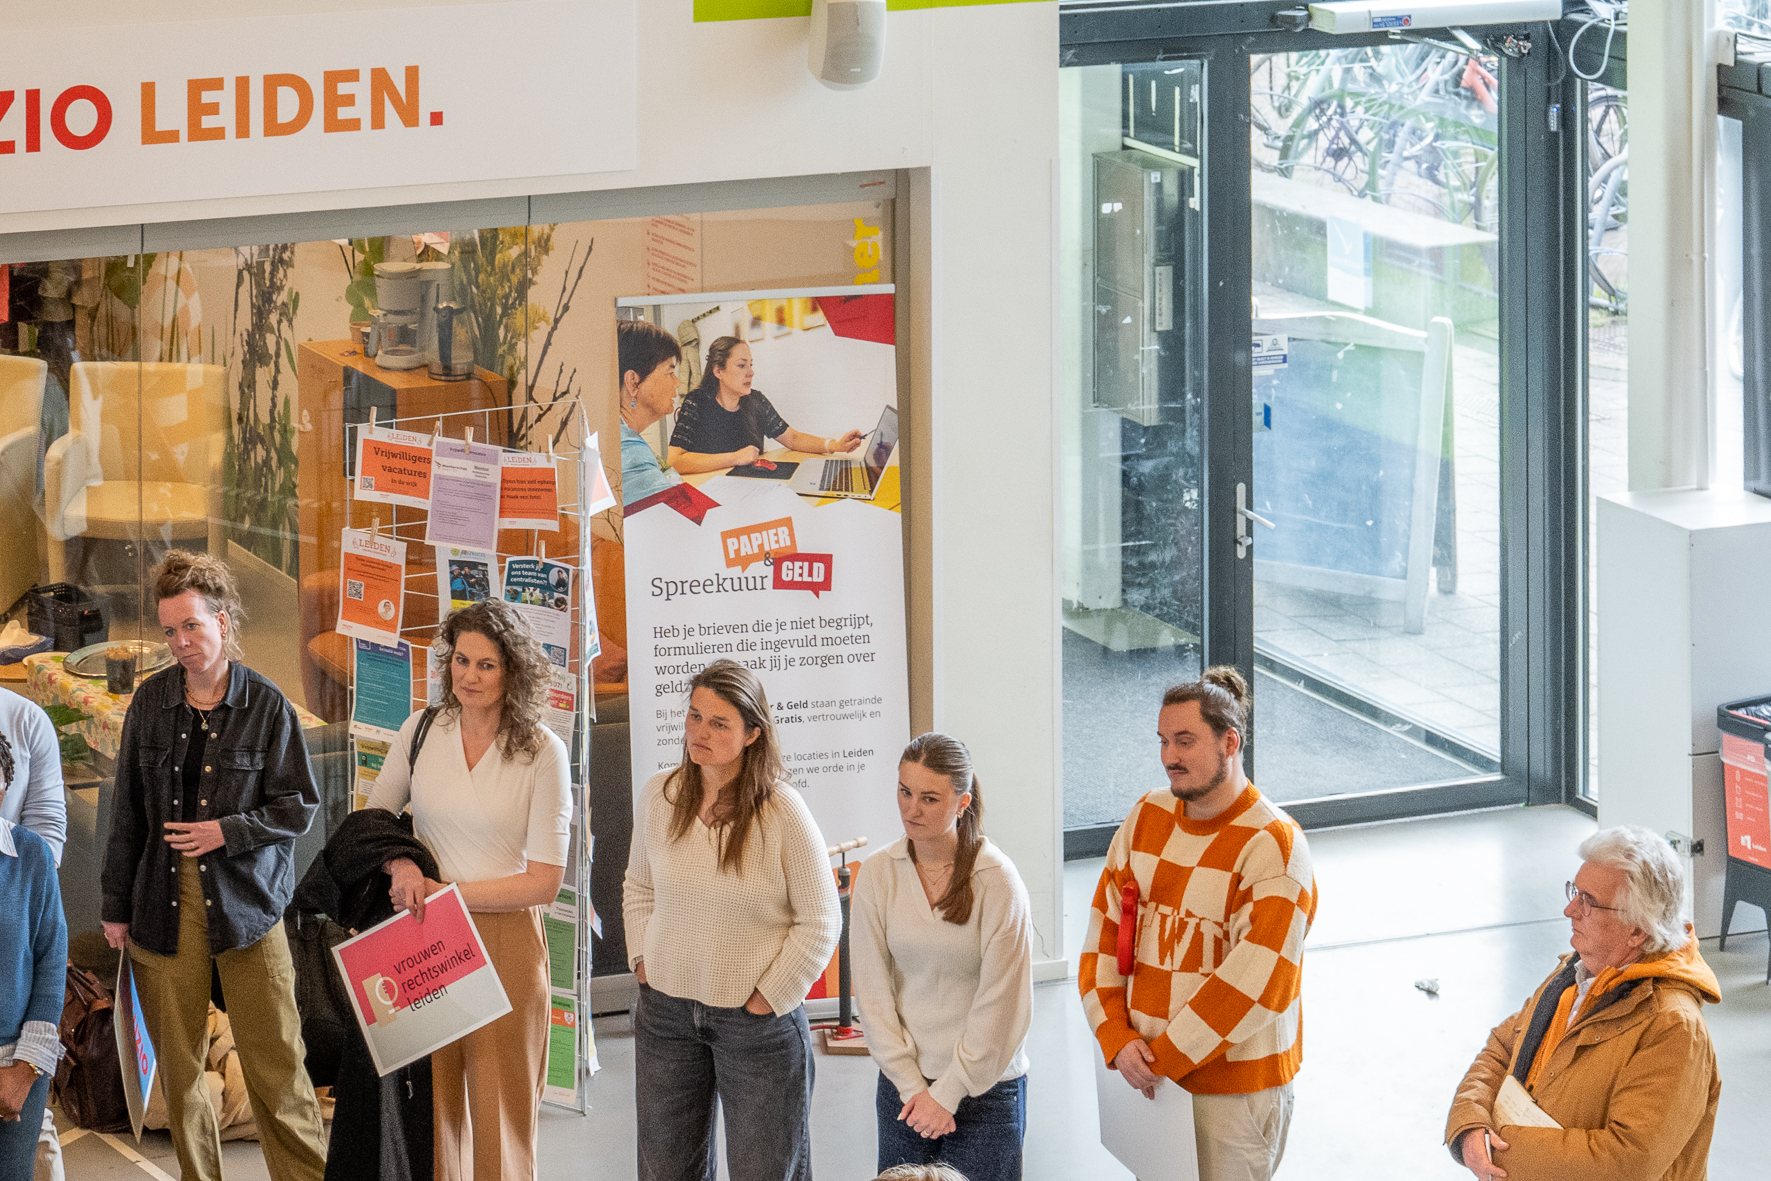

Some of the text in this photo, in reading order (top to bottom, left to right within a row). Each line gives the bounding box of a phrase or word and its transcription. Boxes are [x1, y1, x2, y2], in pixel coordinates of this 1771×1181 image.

[138, 65, 445, 147] LEIDEN.
[373, 446, 432, 465] Vrijwilligers
[381, 464, 427, 479] vacatures
[726, 526, 791, 559] PAPIER
[763, 552, 776, 567] &
[781, 561, 825, 583] GELD
[651, 571, 768, 600] Spreekuur
[653, 613, 873, 640] Heb je brieven die je niet begrijpt,
[654, 632, 871, 657] formulieren die ingevuld moeten
[769, 656, 781, 671] jij
[784, 655, 796, 671] je
[799, 653, 844, 670] zorgen
[847, 651, 875, 665] over
[656, 708, 686, 720] Bij het
[777, 696, 883, 711] & Geld staan getrainde
[807, 711, 867, 723] vertrouwelijk
[869, 710, 881, 718] en
[794, 751, 829, 761] locaties
[831, 750, 840, 758] in
[843, 748, 874, 758] Leiden
[806, 766, 820, 774] we
[822, 764, 844, 773] orde
[846, 763, 855, 771] in
[857, 762, 865, 773] je
[394, 940, 445, 974] vrouwen
[401, 943, 475, 993] rechtswinkel
[406, 984, 448, 1012] leiden
